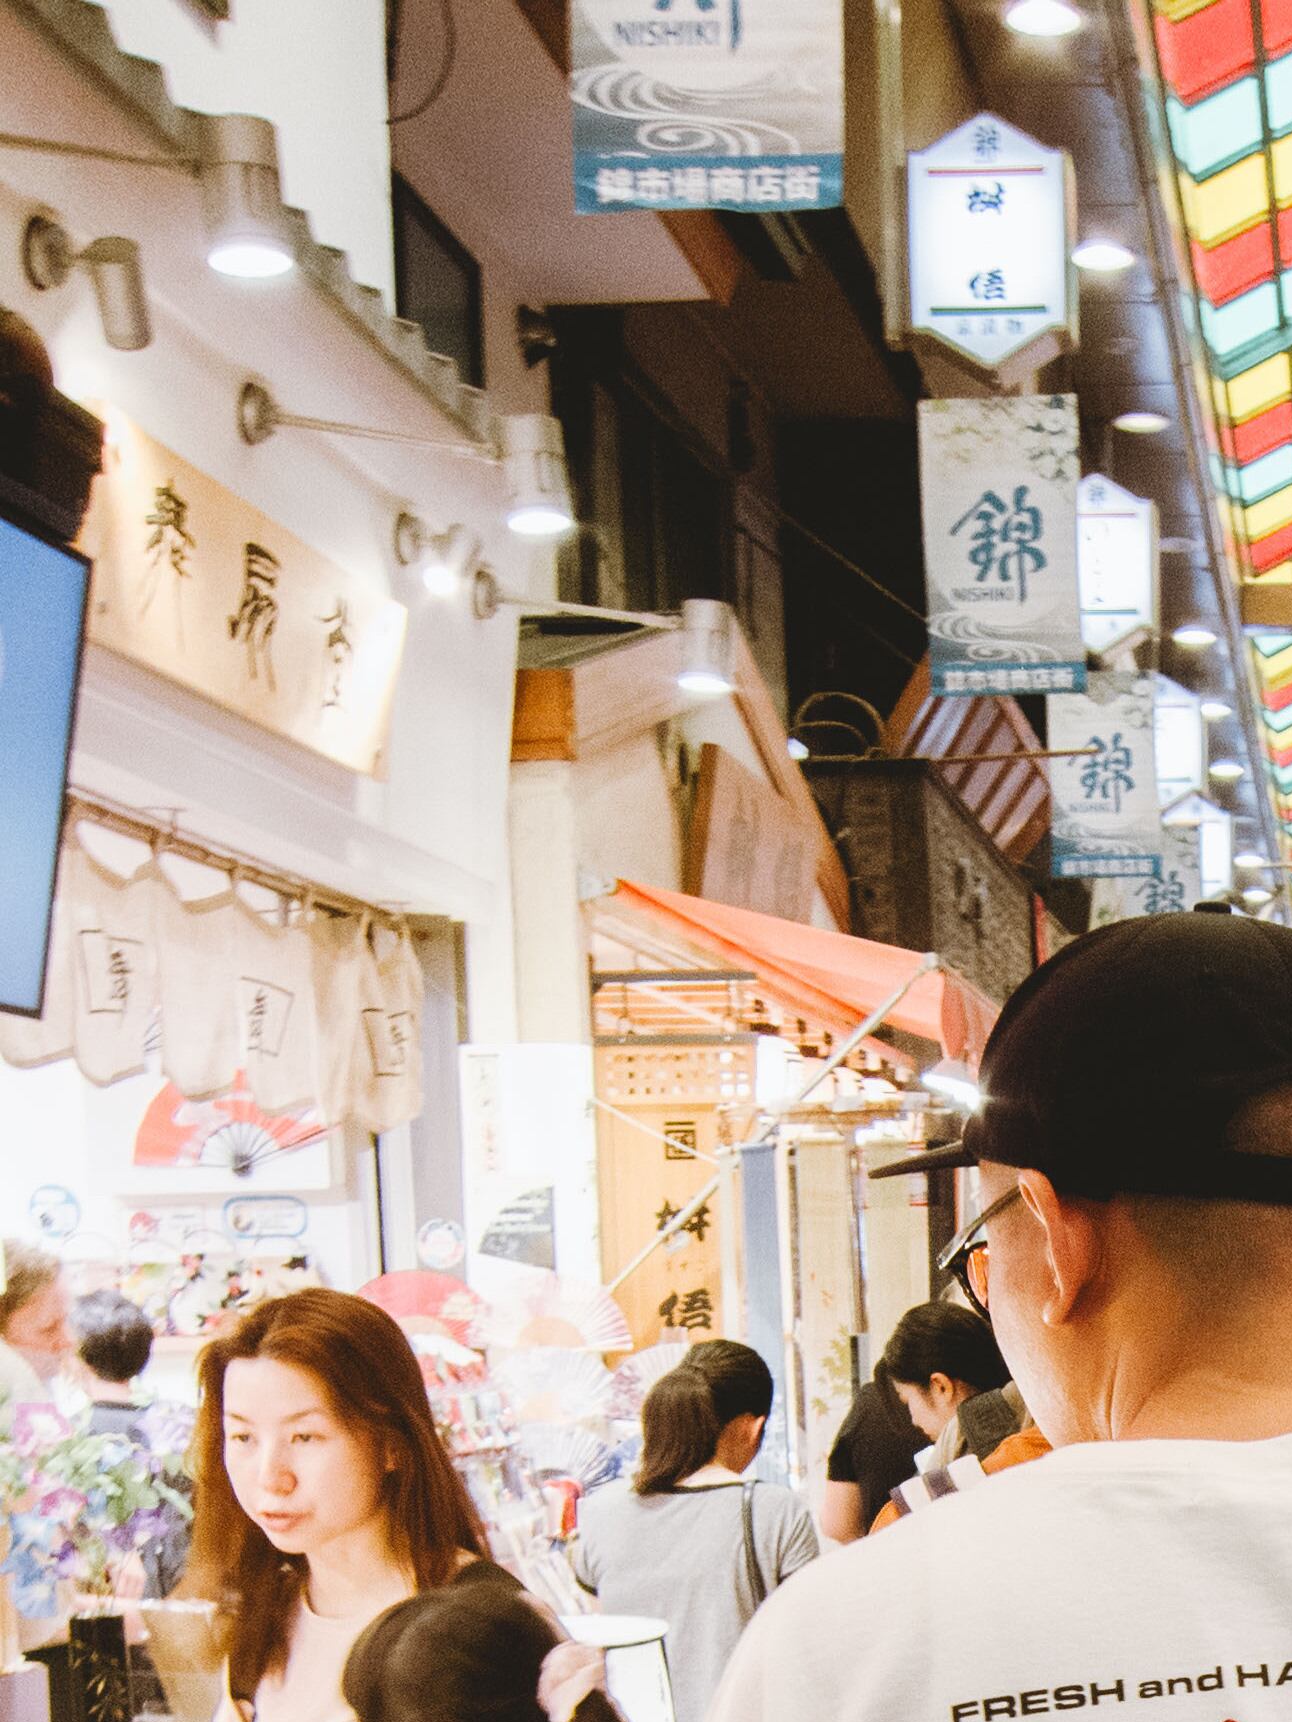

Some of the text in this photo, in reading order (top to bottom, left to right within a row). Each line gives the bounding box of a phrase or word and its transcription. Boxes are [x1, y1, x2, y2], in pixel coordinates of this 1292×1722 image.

[951, 485, 1047, 604] 錦
[1067, 732, 1135, 815] 錦
[1138, 1666, 1225, 1699] and
